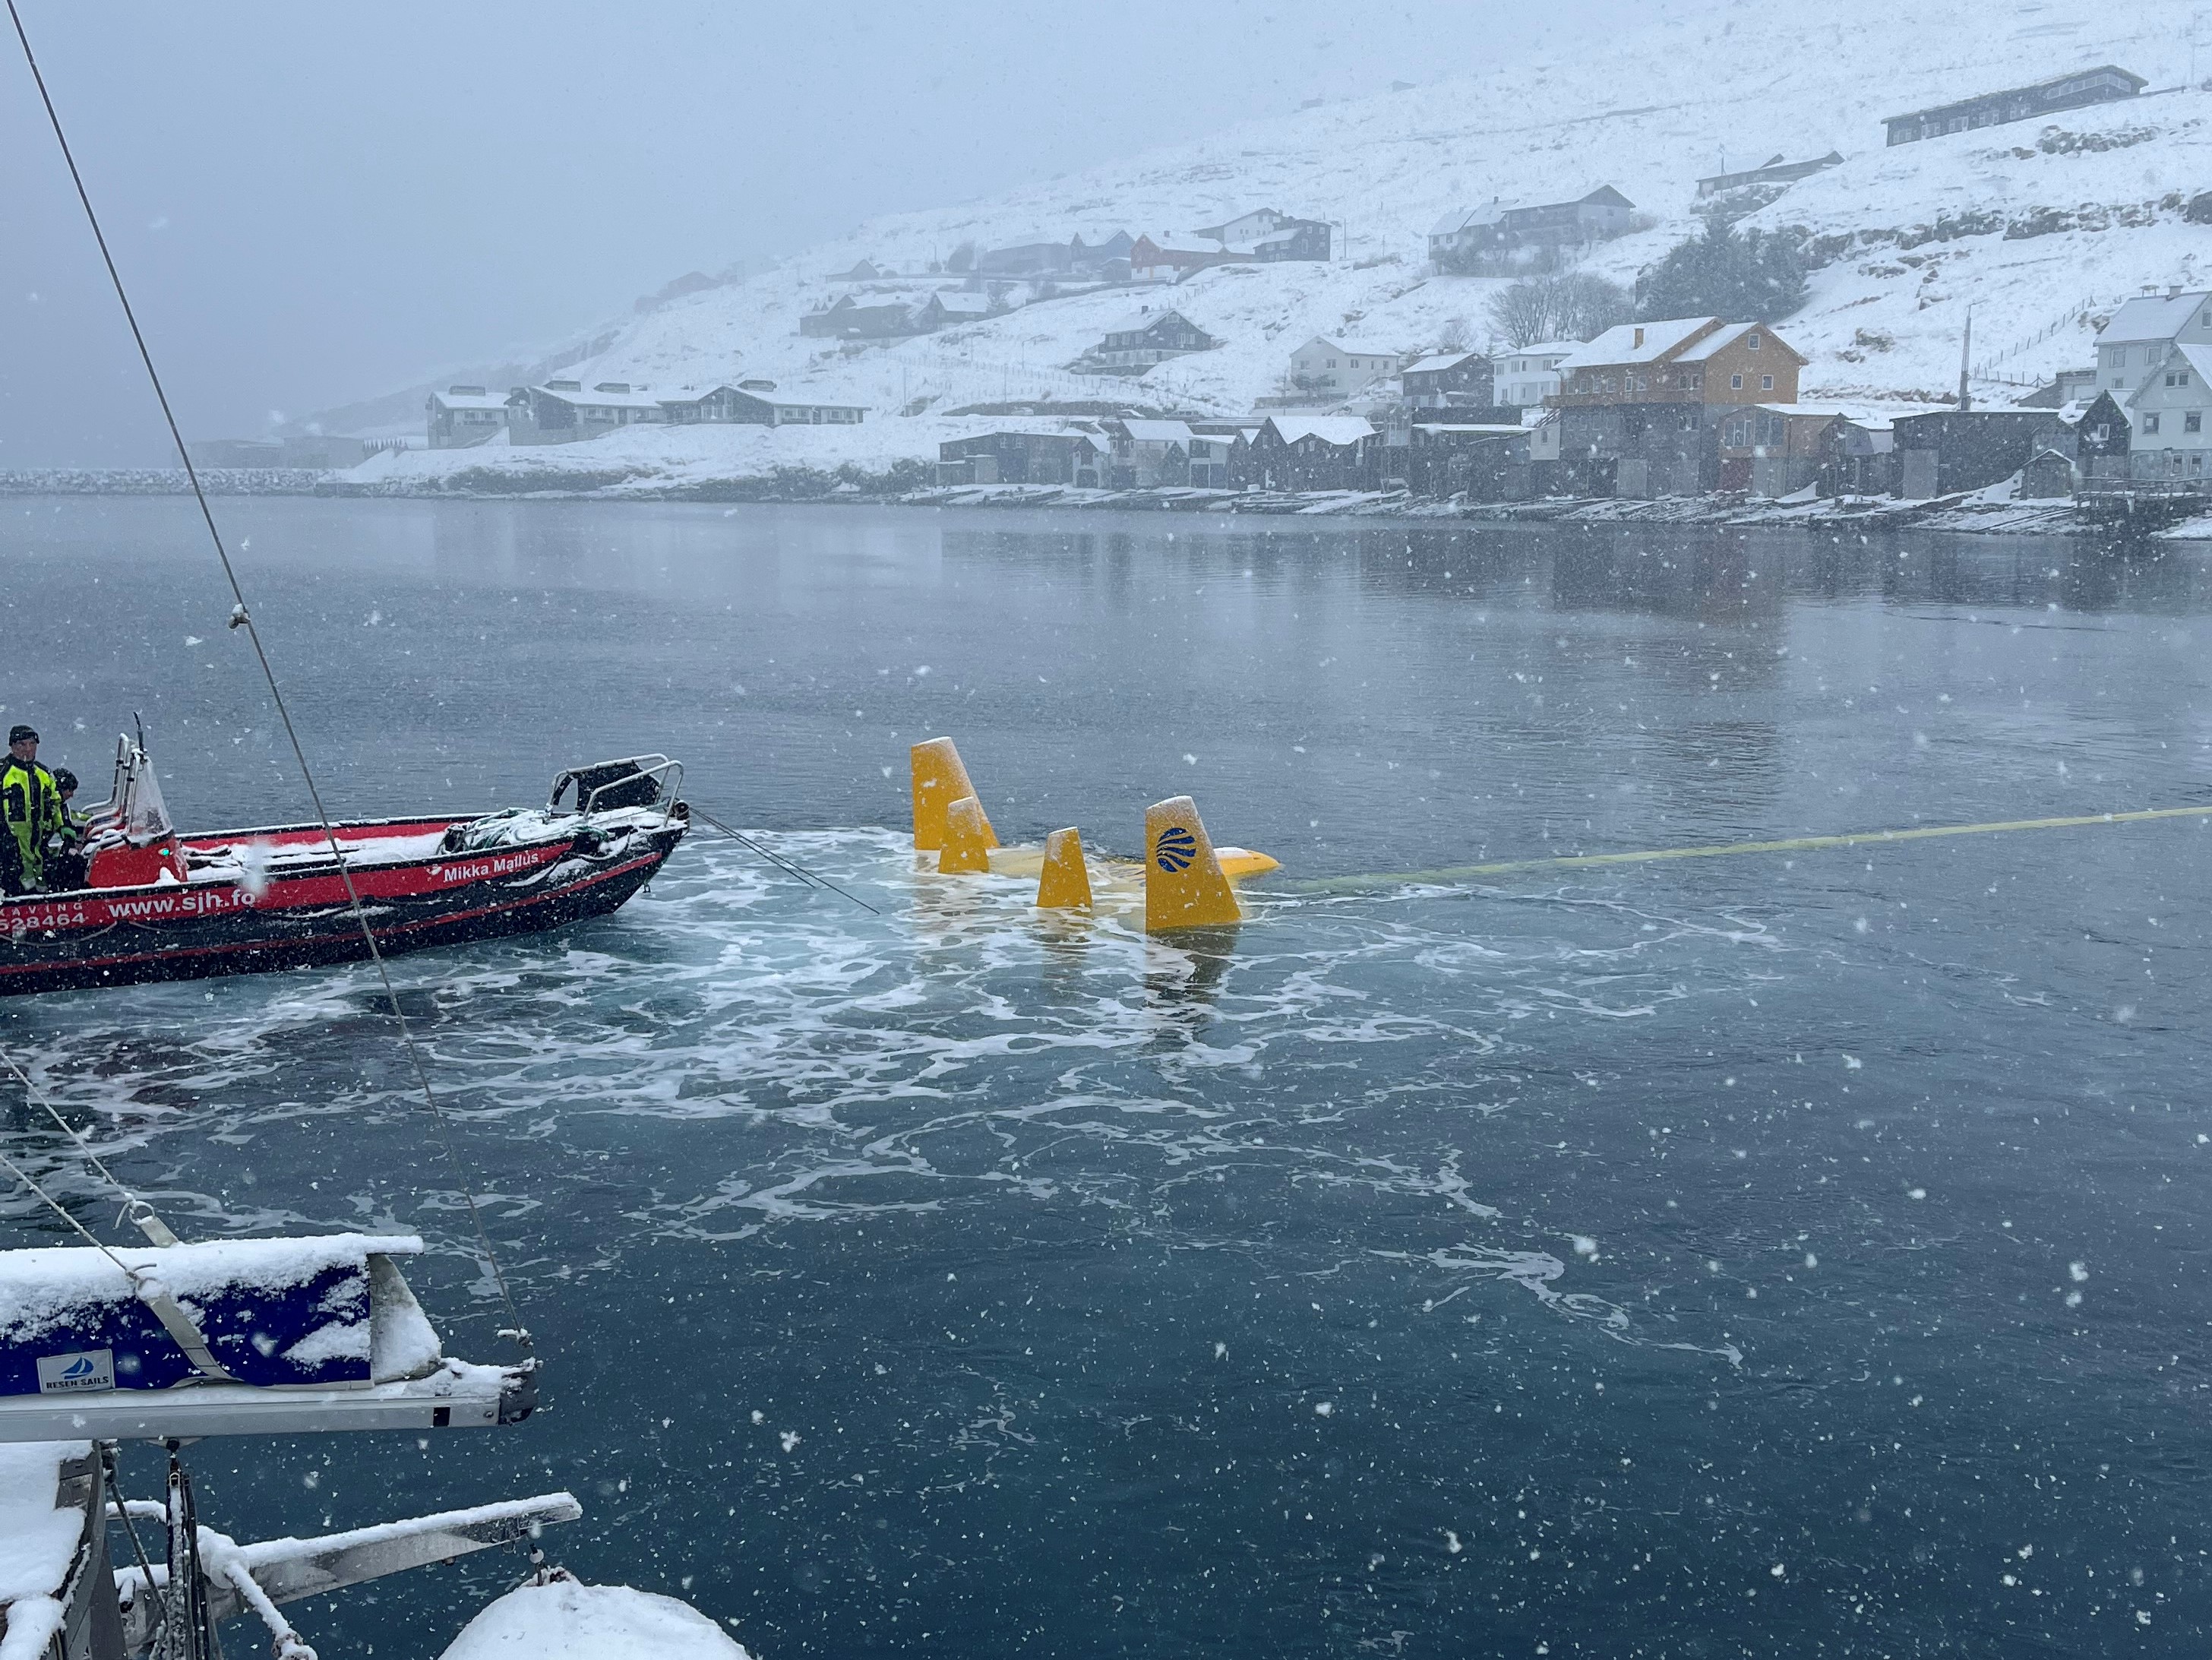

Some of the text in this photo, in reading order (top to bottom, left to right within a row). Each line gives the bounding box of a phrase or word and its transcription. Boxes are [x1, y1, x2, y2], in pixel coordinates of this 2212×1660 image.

[444, 865, 489, 882] Mikka
[109, 889, 256, 917] www.sjh.fo
[46, 1376, 109, 1389] RESEN SAILS
